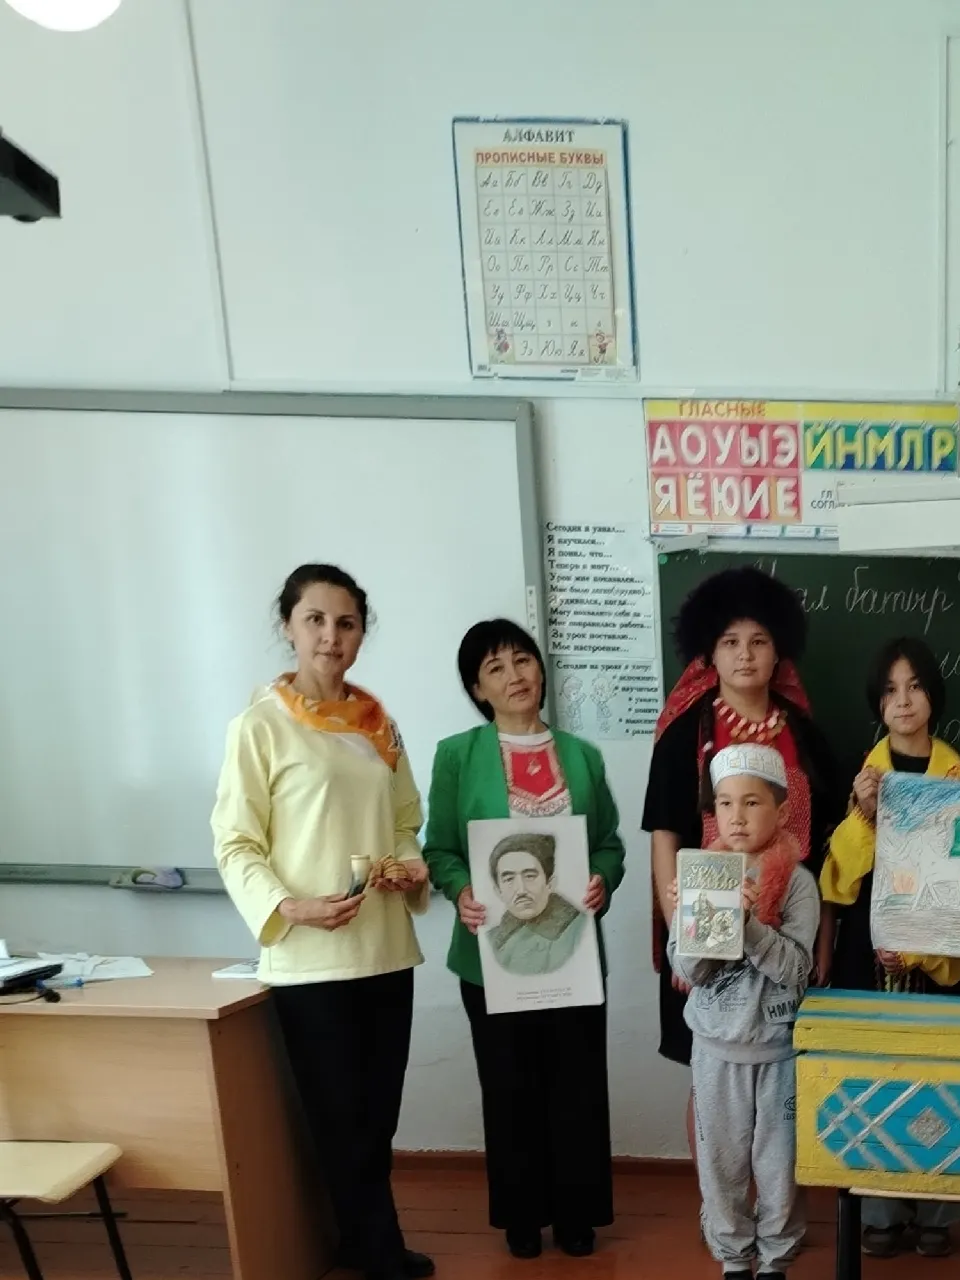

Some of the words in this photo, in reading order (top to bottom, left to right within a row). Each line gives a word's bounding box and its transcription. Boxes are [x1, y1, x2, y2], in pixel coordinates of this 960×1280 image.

[502, 128, 575, 143] АЛФАВИТ
[476, 152, 556, 164] ПРОПИСНЫЕ
[559, 152, 604, 165] БУКВЫ
[679, 400, 766, 418] ГЛАСНЫЕ
[546, 522, 581, 534] Сегодня
[547, 534, 554, 544] Я
[547, 547, 555, 557] Я
[548, 560, 580, 571] Теперь
[551, 629, 563, 638] За
[566, 632, 587, 640] урок
[556, 660, 587, 670] Сегодня
